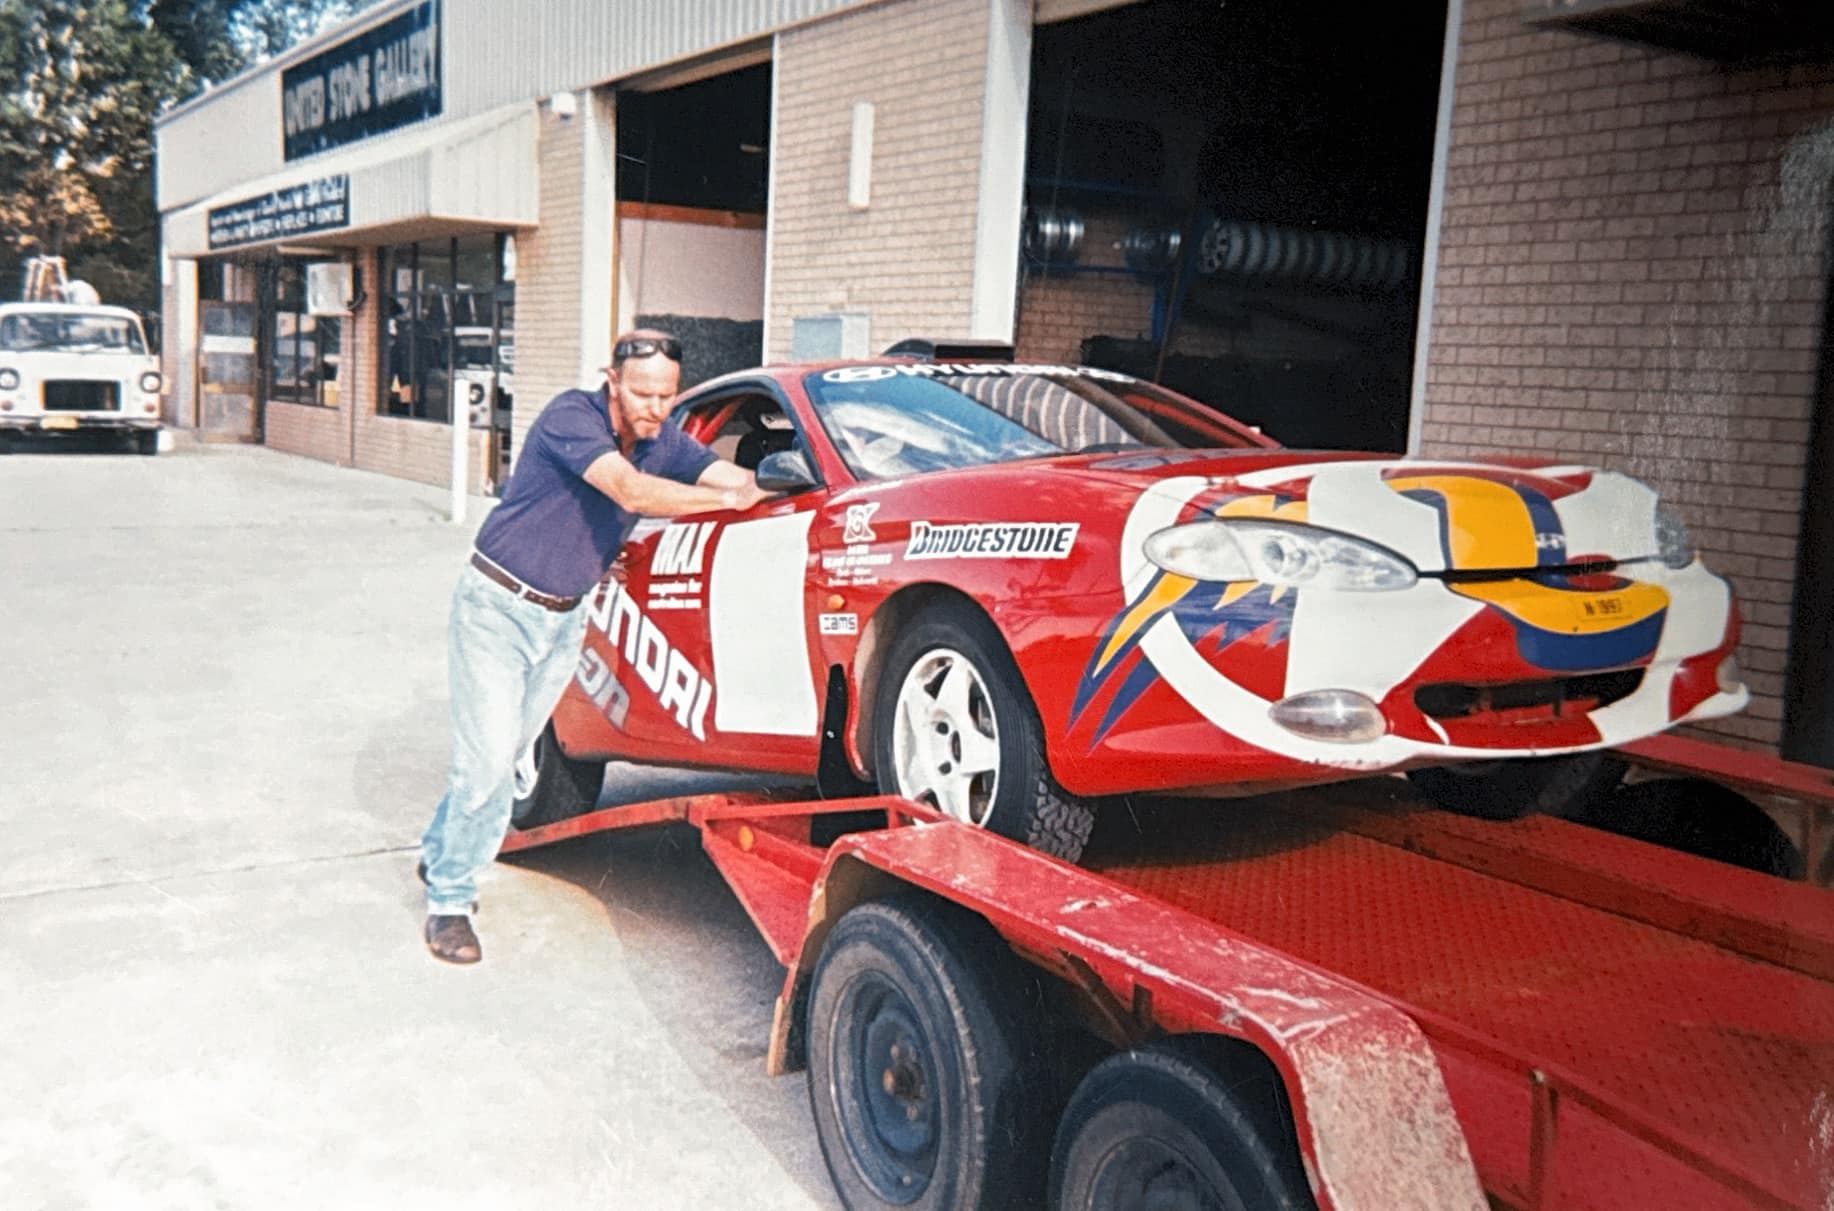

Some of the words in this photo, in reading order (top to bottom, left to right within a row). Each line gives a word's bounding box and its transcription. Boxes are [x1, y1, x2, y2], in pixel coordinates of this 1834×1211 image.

[375, 24, 437, 106] GALLERY
[909, 524, 1073, 555] BRIDGESTONE
[588, 576, 712, 742] UNDAI
